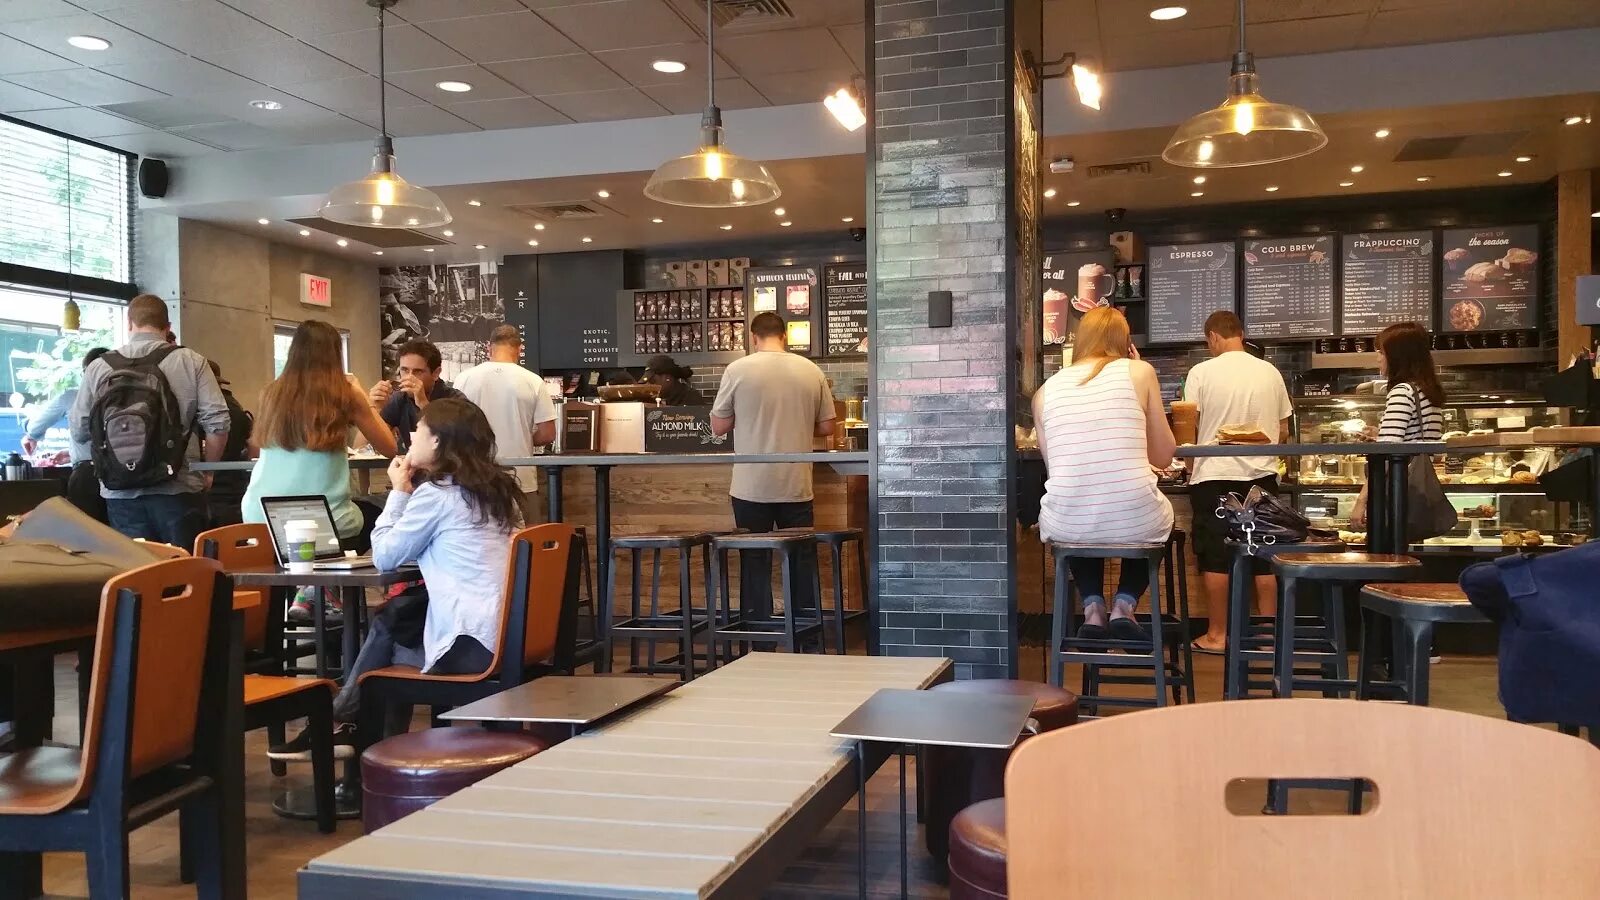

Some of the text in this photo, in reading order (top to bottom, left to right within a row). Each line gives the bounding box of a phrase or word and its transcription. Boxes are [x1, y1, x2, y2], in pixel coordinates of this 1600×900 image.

[1469, 237, 1509, 246] the season
[1261, 244, 1315, 254] COLD BREW
[1170, 250, 1214, 259] ESPRESSO
[1052, 270, 1064, 279] all
[310, 278, 328, 299] EXIT
[651, 421, 702, 431] ALMOND MILK
